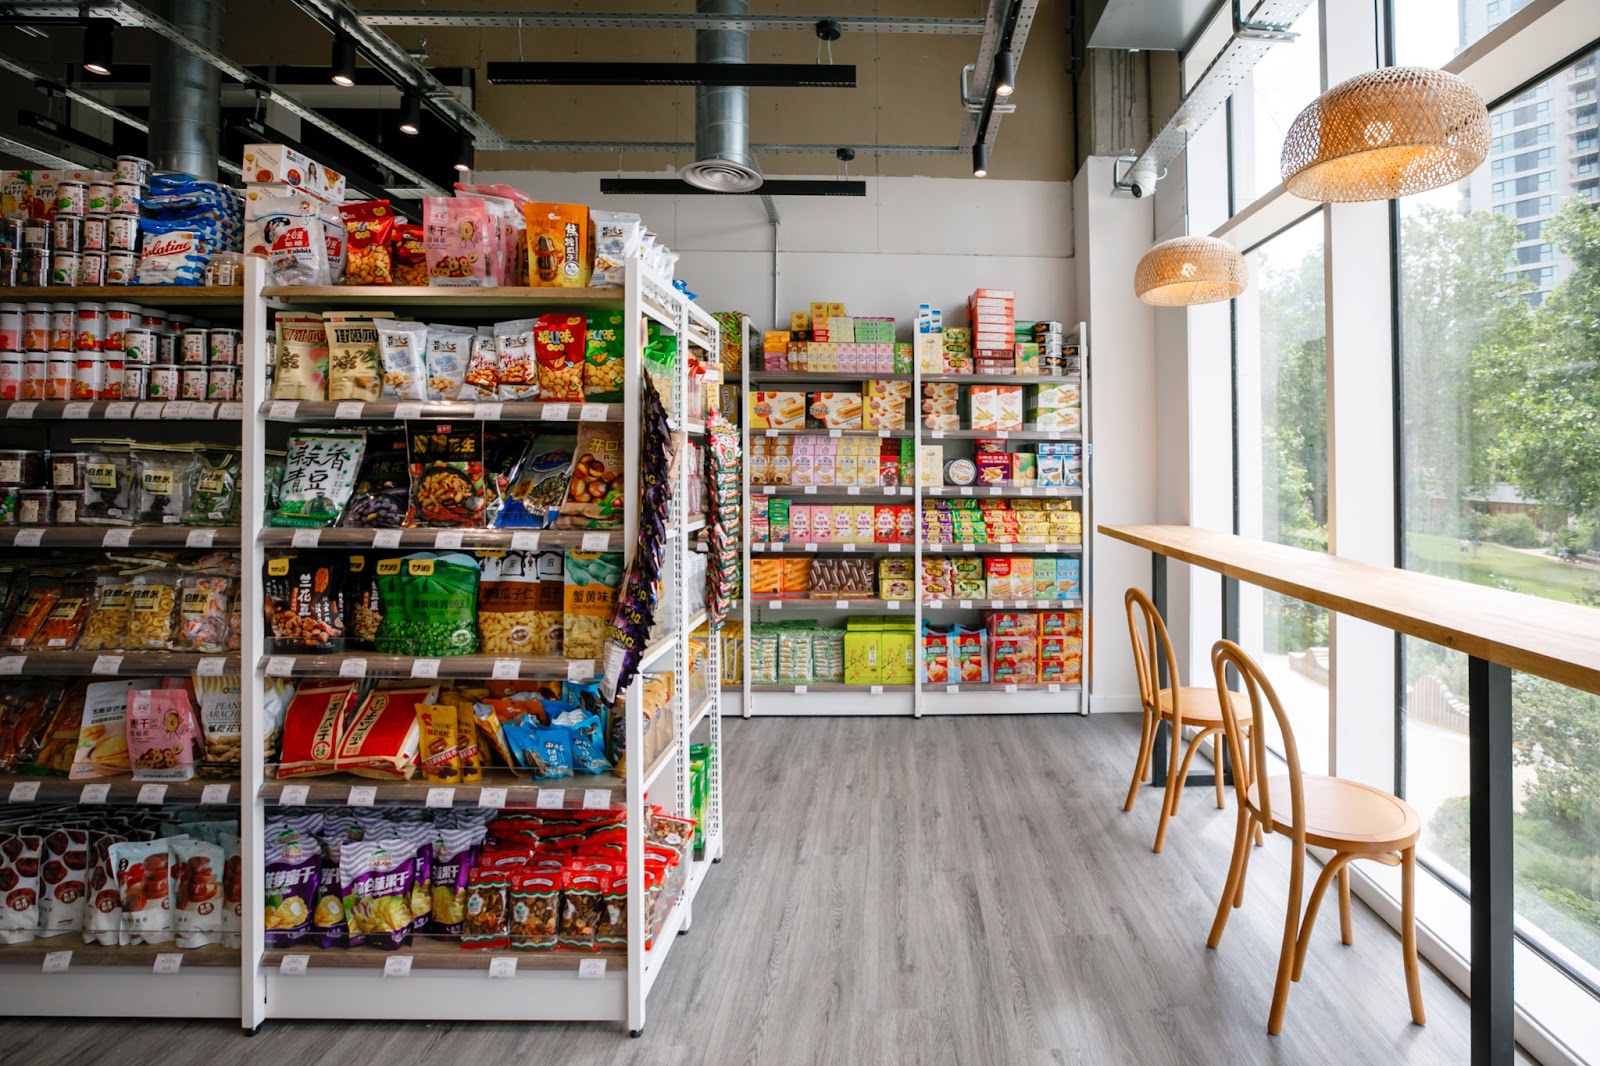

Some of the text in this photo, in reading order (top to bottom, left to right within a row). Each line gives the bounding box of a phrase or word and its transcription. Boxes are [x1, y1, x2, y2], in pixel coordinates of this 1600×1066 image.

[338, 329, 379, 343] 甘草瓜
[588, 437, 624, 452] 开口
[290, 444, 350, 472] 蒜香
[144, 474, 170, 483] 自然派
[283, 467, 328, 494] 青豆
[132, 590, 159, 599] 自然派
[184, 593, 208, 603] 自然派
[297, 573, 312, 617] 兰花豆
